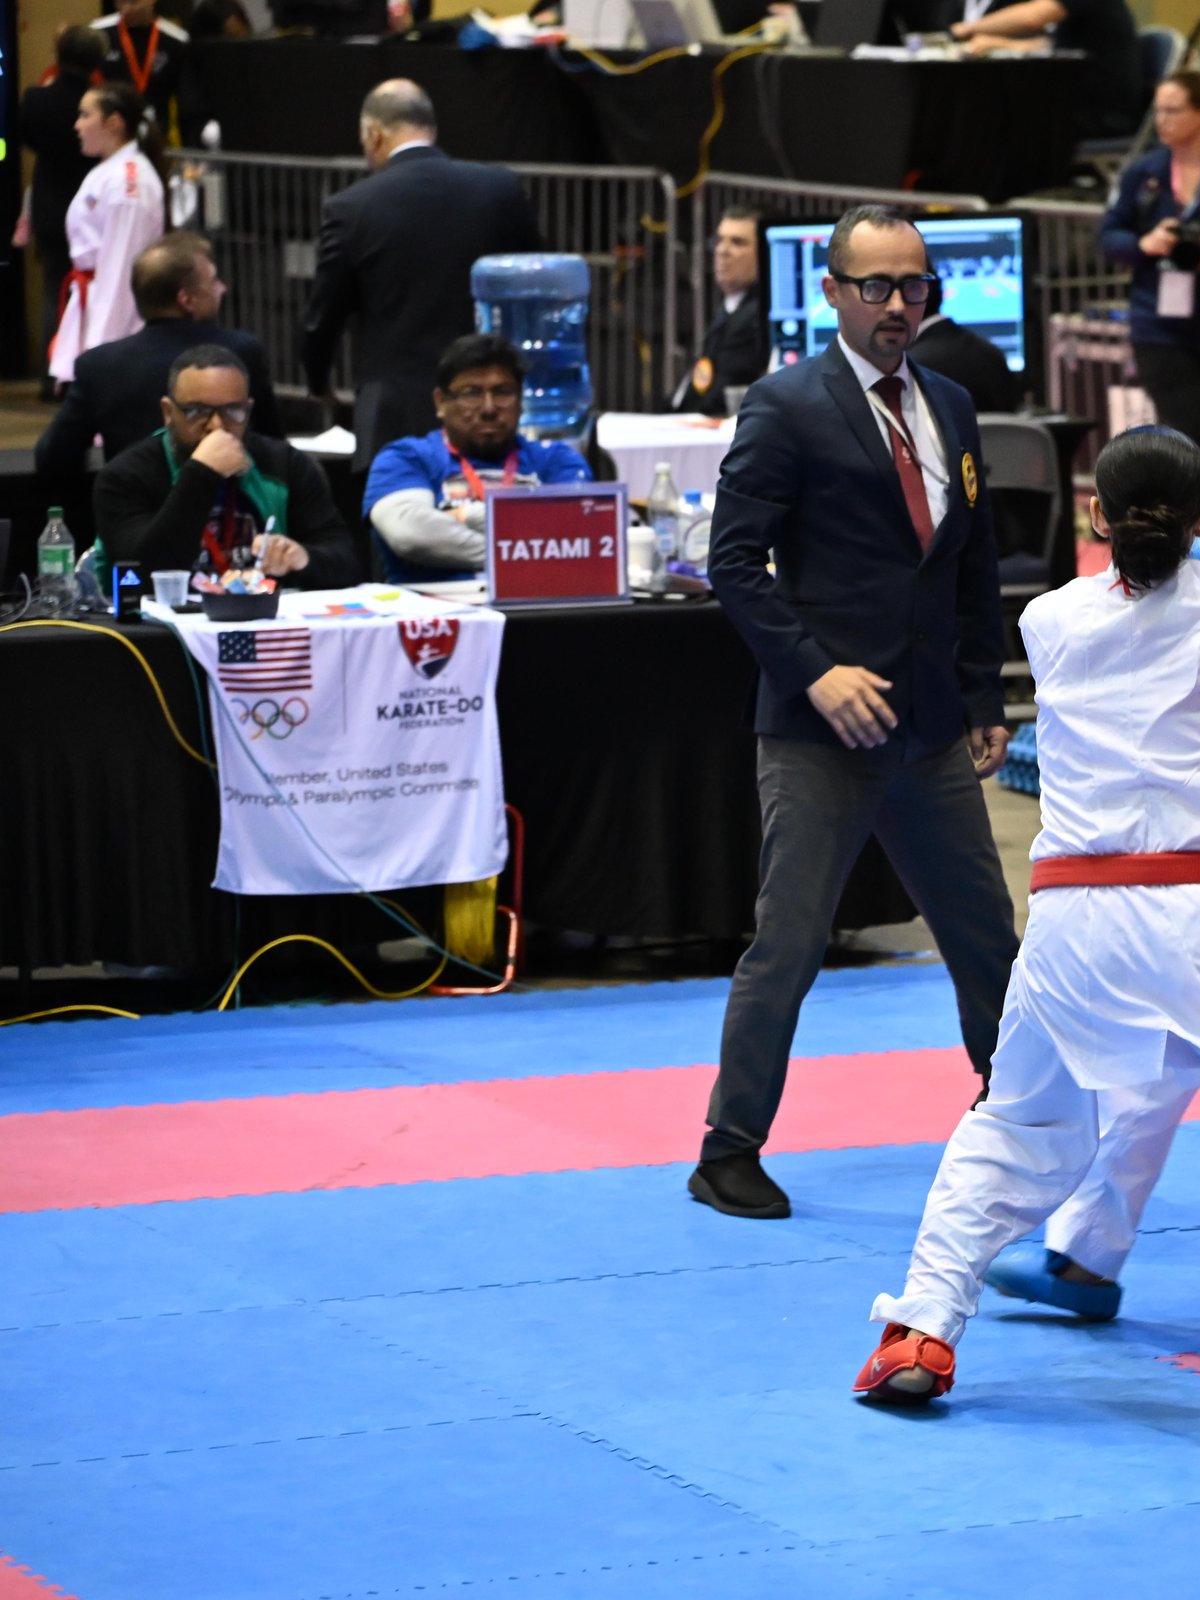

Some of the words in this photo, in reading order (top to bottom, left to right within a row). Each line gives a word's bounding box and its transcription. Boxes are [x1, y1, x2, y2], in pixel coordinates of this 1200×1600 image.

[497, 537, 591, 561] TATAMI
[599, 535, 615, 557] 2
[404, 617, 453, 640] USA
[399, 686, 462, 700] NATIONAL
[377, 696, 484, 721] KARATE-DO
[399, 717, 465, 730] FEDERATION
[336, 765, 392, 782] United
[396, 762, 448, 777] States
[303, 786, 396, 805] Paralympic
